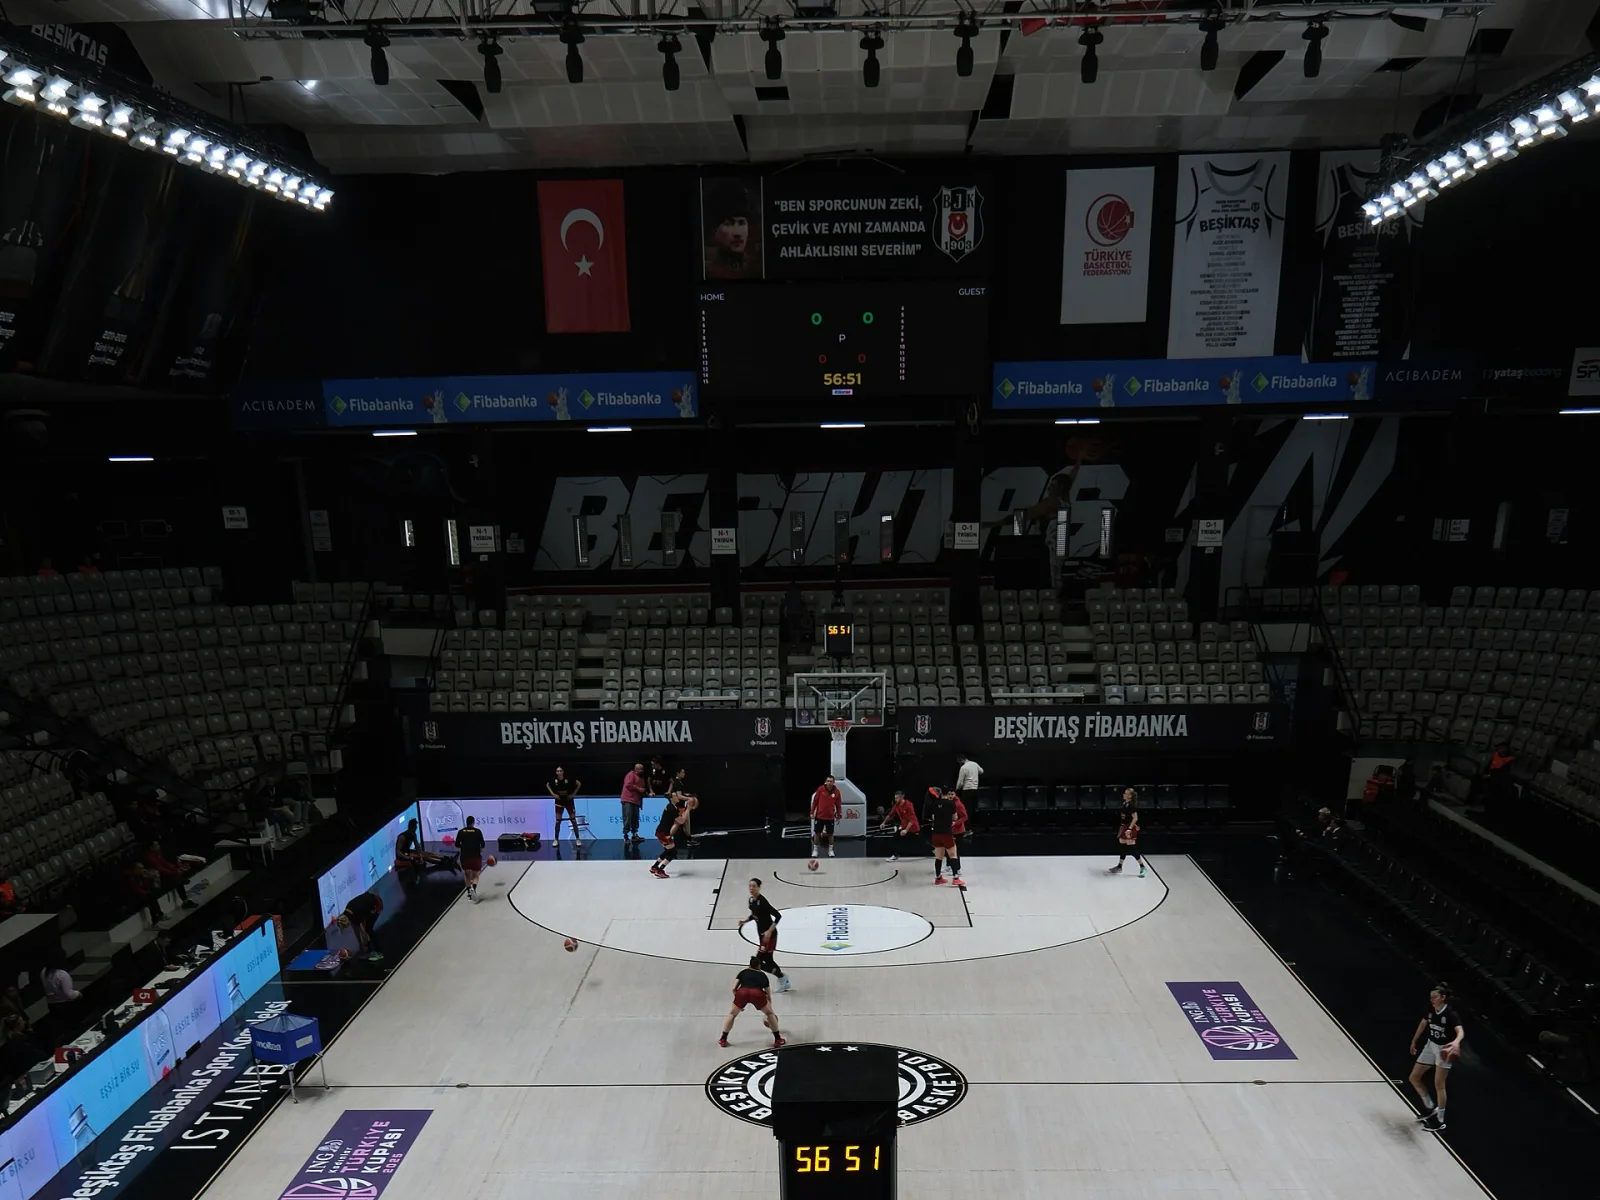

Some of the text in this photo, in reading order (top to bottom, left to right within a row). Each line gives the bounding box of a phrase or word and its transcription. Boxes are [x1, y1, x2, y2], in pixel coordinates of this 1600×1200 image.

[808, 198, 887, 211] SPORCUNUN
[889, 195, 923, 211] ZEKİ,
[943, 193, 975, 208] BJK
[771, 221, 926, 240] ÇEVİK VE AYNI ZAMANDA
[1199, 214, 1260, 233] BEŞİKTAŞ
[944, 240, 973, 251] 1903
[1084, 248, 1132, 261] TÜRKİYE
[1083, 261, 1132, 270] BASKETBOL
[700, 293, 725, 301] HOME
[958, 288, 986, 296] GUEST
[811, 312, 823, 326] 0
[862, 311, 874, 325] 0
[838, 333, 846, 343] P
[1385, 369, 1463, 382] ACIBADEM
[1576, 365, 1600, 378] SP
[823, 372, 861, 386] 56:51
[1144, 378, 1210, 392] Fibabanka
[1271, 374, 1337, 389] Fibabanka
[1017, 380, 1083, 395] Fibabanka
[242, 400, 316, 412] ACIBADEM
[350, 398, 414, 412] Fibabanka
[473, 395, 538, 408] Fibabanka
[597, 392, 662, 406] Fibabanka
[828, 625, 850, 635] 56 51
[500, 716, 693, 750] BEŞİKTAŞ FİBABANKA
[993, 710, 1188, 744] BEŞİKTAŞ FİBABANKA
[476, 815, 526, 825] ŞSİZ BİR SU
[826, 907, 849, 941] Fibabanka
[1221, 993, 1256, 1024] KUPASI
[120, 1078, 213, 1142] Fibabanka
[191, 1051, 240, 1077] Spor
[218, 1000, 292, 1050] Komleksi
[897, 1050, 957, 1122] BASKETBO
[361, 1128, 406, 1174] KUPASI
[305, 1153, 335, 1174] ING
[382, 1153, 404, 1174] 2025
[796, 1145, 880, 1172] 56 51
